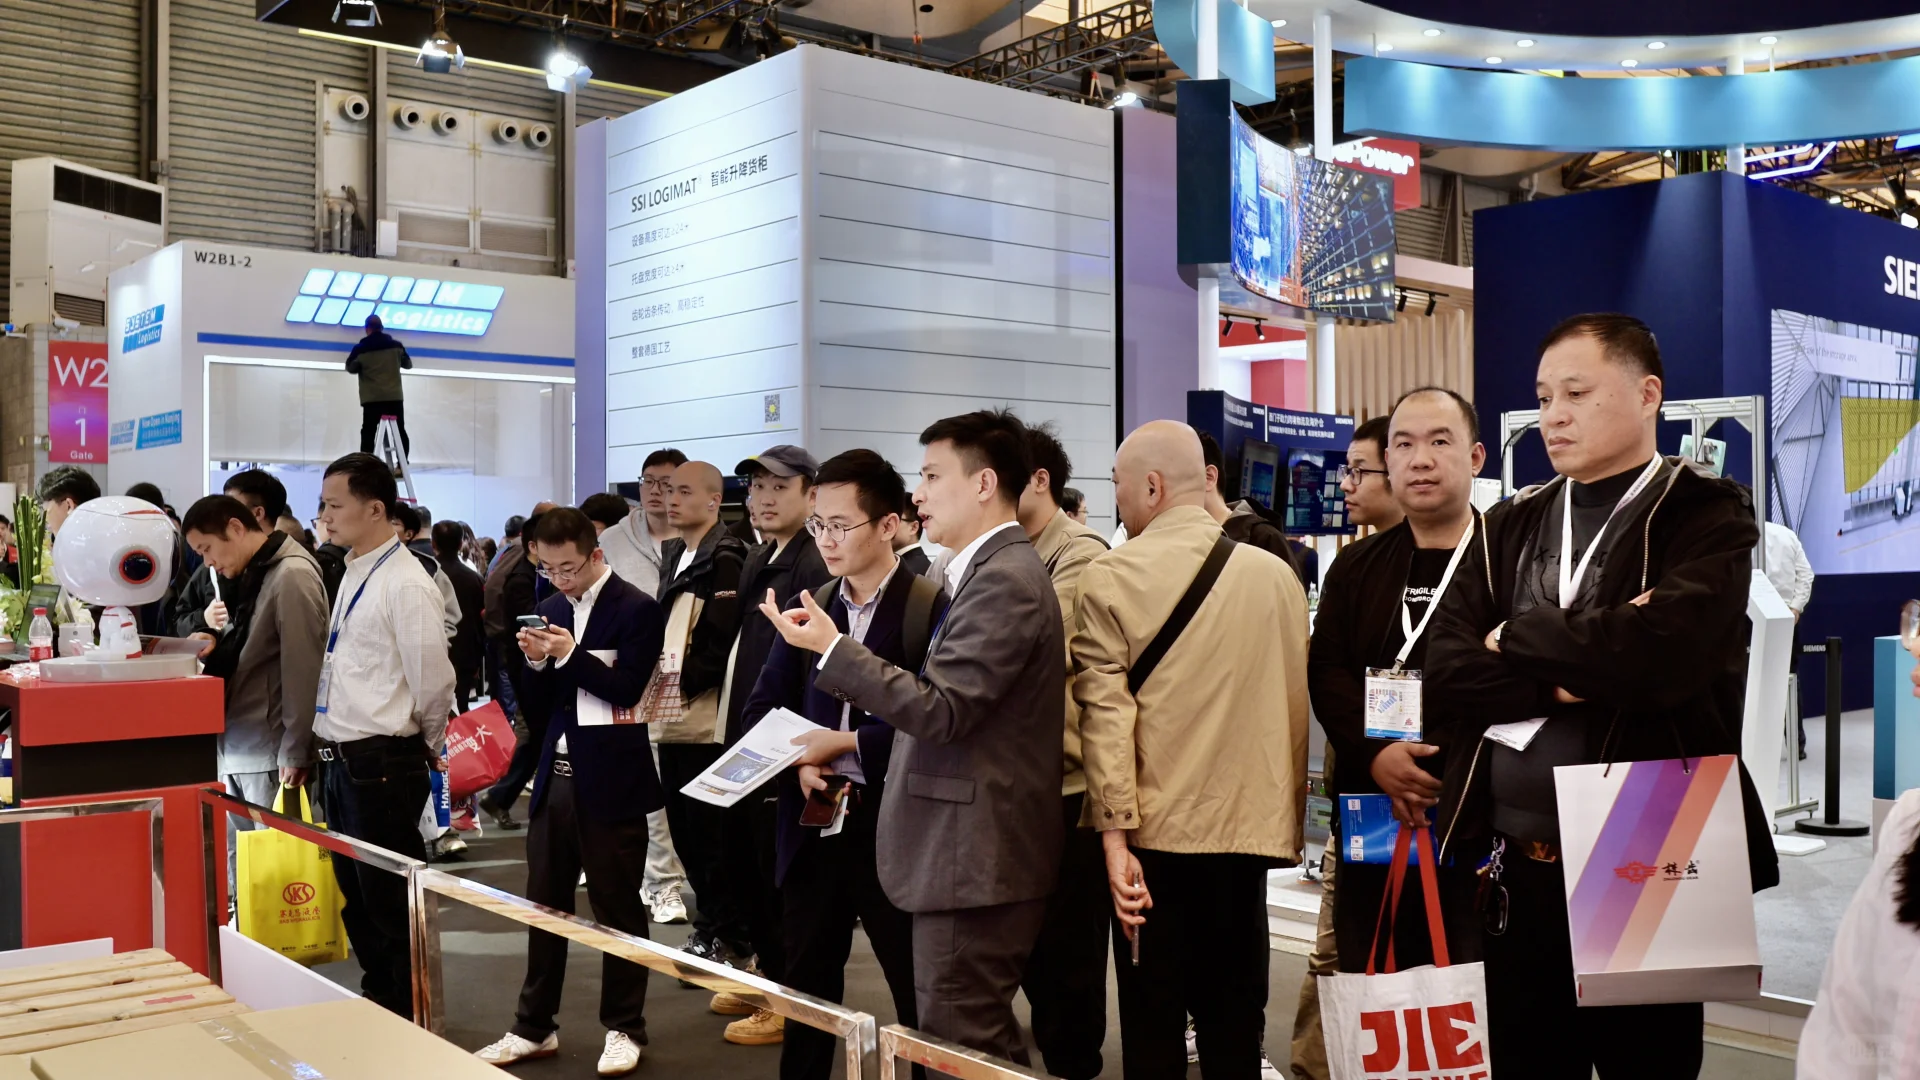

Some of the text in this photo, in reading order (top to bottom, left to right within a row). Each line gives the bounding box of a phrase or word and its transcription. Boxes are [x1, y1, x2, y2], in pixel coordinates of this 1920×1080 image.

[631, 193, 646, 213] SSI
[711, 154, 768, 188] 智能升降货柜
[194, 250, 253, 268] W2B1-2
[379, 306, 485, 332] Logistics
[138, 328, 161, 345] Logistics
[53, 355, 108, 388] W2
[75, 418, 86, 447] 1
[70, 450, 94, 461] Gate
[1360, 1001, 1485, 1073] JIE
